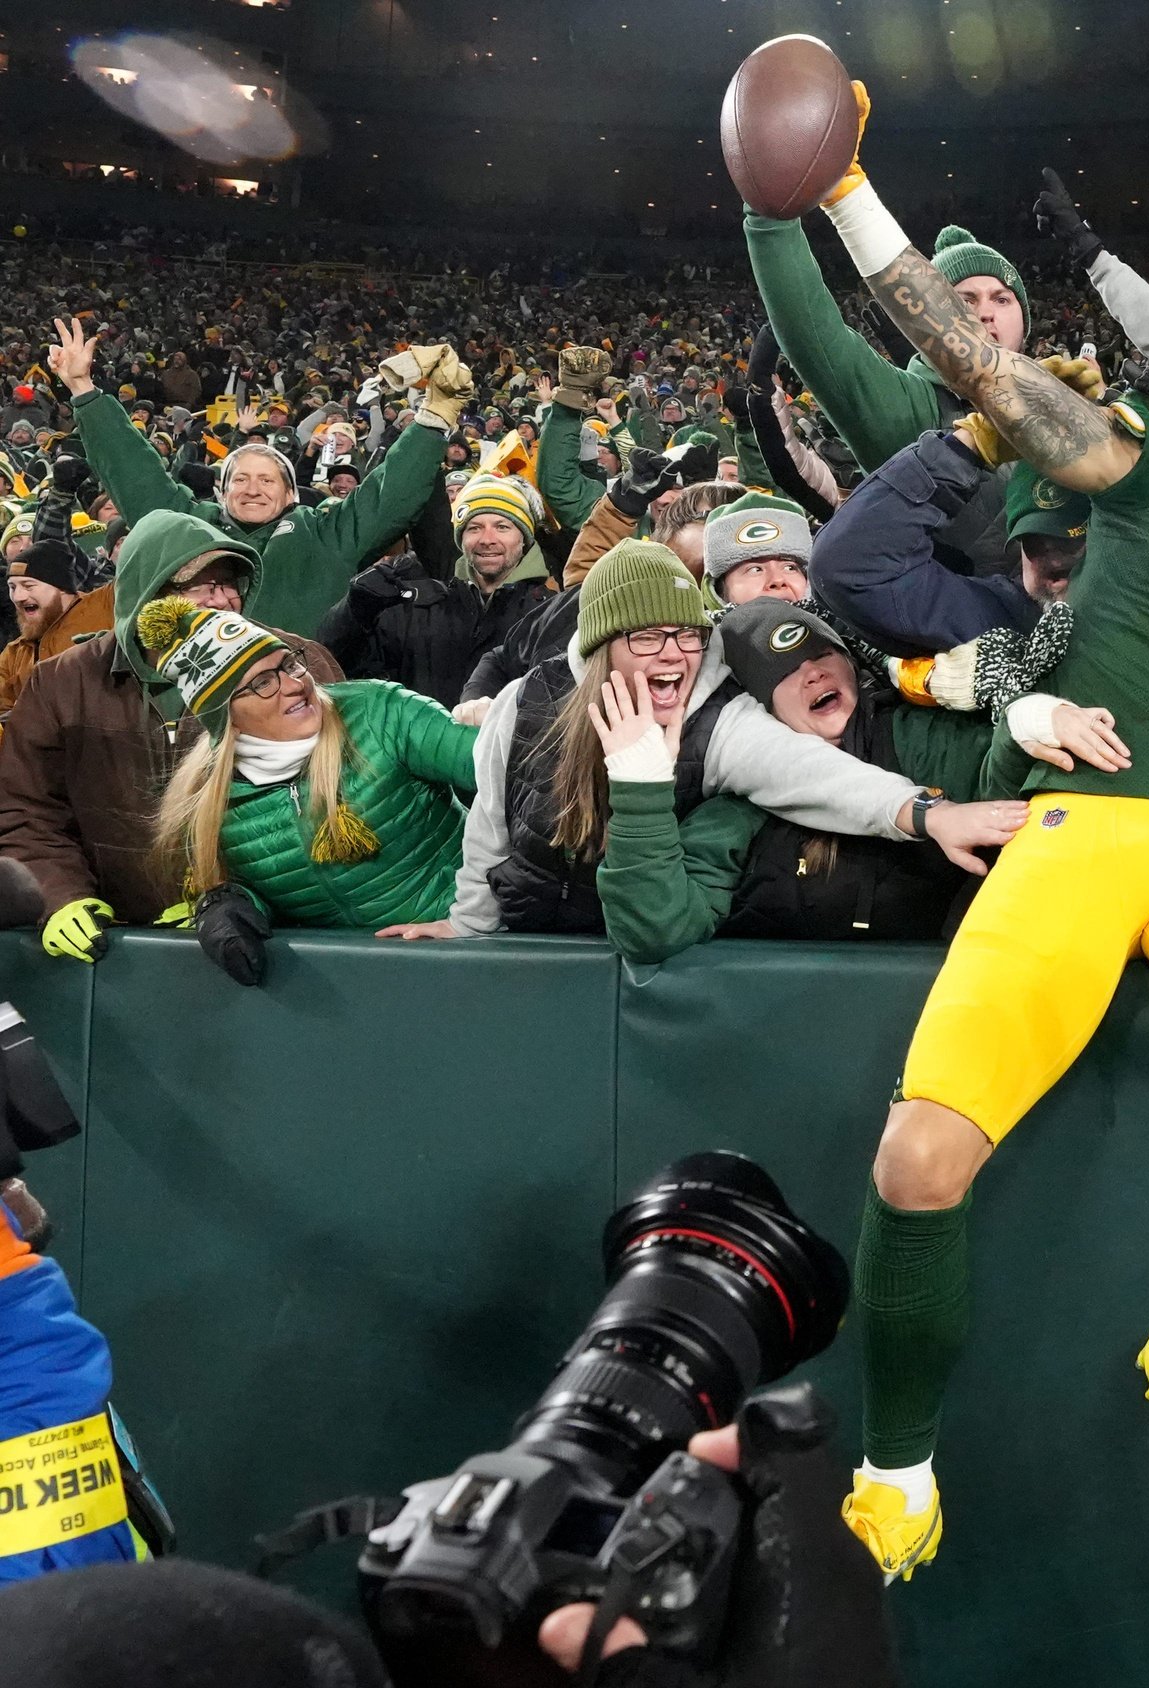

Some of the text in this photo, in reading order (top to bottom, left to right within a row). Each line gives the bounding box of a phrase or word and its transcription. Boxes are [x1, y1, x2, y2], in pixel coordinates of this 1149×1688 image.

[738, 521, 779, 544] G
[219, 621, 248, 641] G
[771, 623, 806, 650] G
[42, 1449, 78, 1467] Field
[0, 1458, 117, 1515] WEEK 10
[60, 1512, 86, 1533] GB
